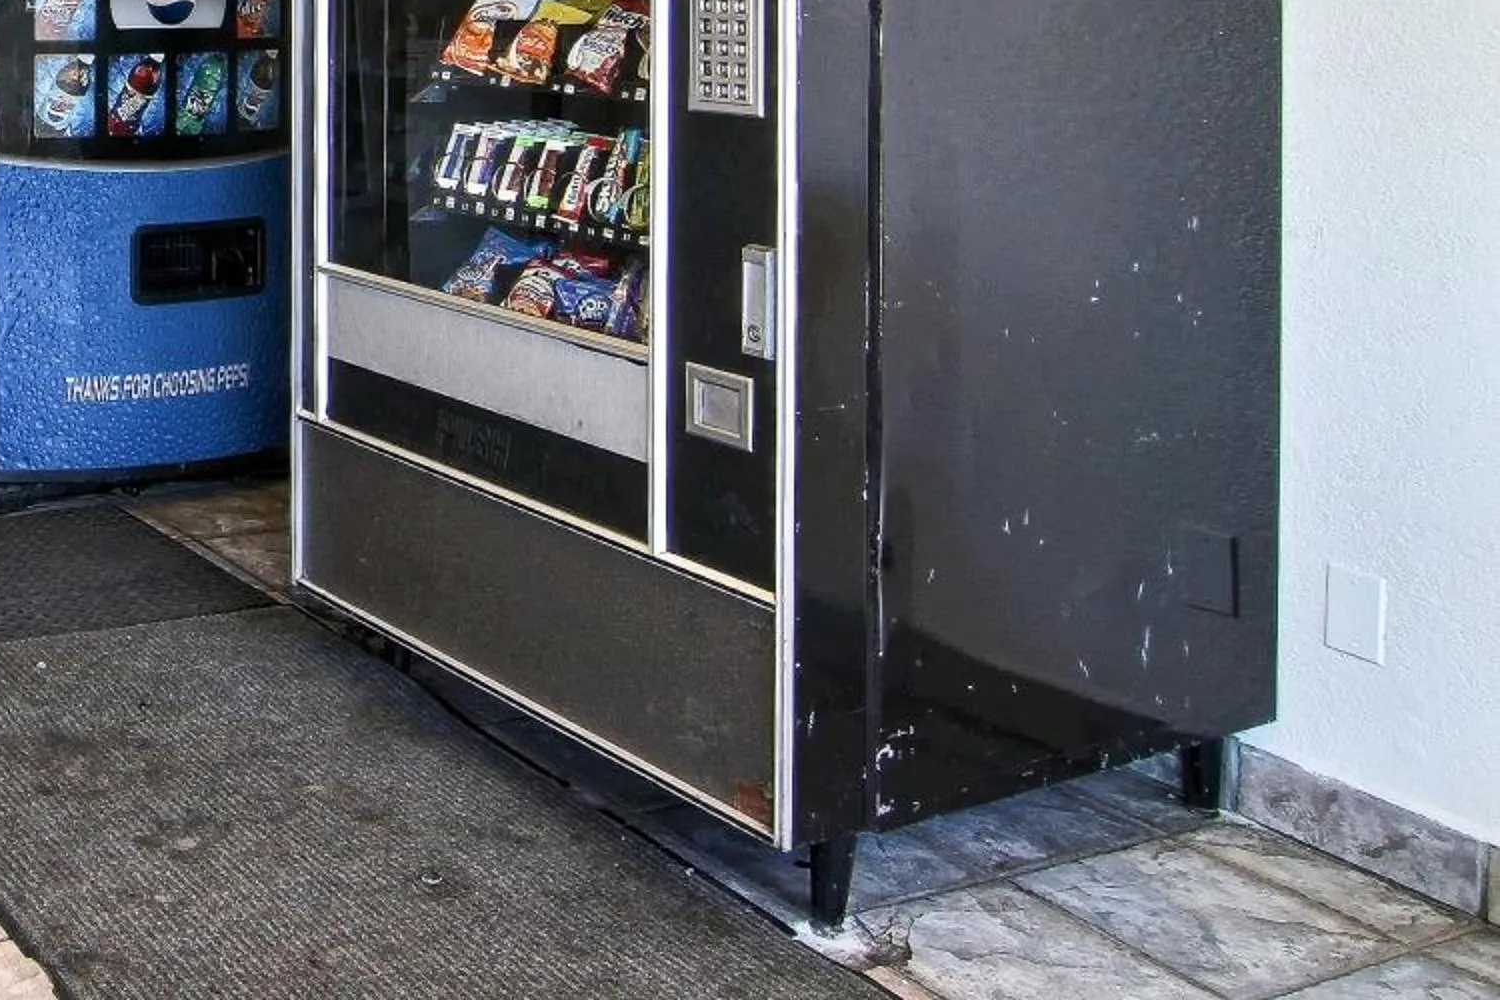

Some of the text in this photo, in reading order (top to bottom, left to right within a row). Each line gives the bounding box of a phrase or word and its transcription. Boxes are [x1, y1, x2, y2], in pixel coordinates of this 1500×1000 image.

[65, 375, 121, 403] THANKS
[123, 374, 150, 400] FOR
[153, 367, 216, 398] CHOOSING
